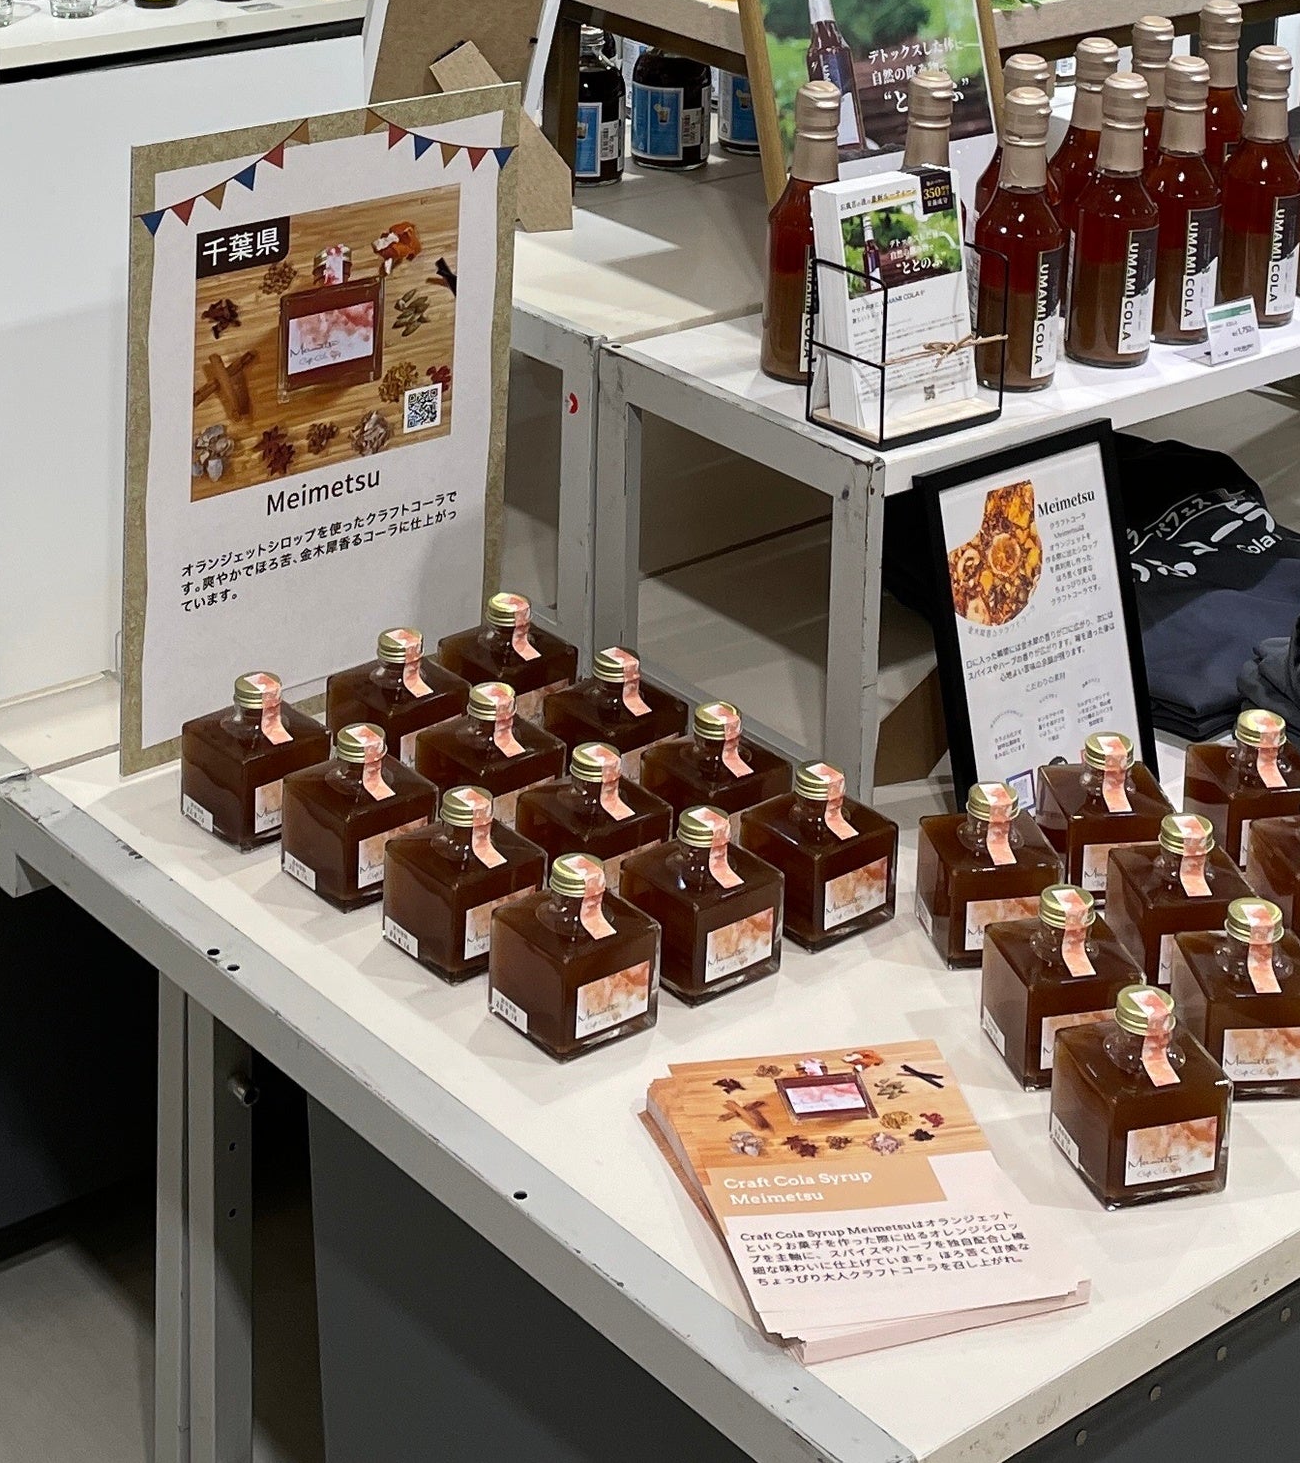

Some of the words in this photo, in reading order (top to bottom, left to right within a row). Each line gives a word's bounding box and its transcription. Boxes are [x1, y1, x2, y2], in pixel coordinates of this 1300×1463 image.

[202, 225, 280, 267] 千葉県
[1184, 221, 1199, 276] UMAMI
[1271, 208, 1286, 260] UMAMI
[1035, 263, 1049, 320] UMAMI
[1124, 242, 1140, 298] UMAMI
[1268, 261, 1280, 304] COLA
[1183, 276, 1195, 319] COLA
[1122, 298, 1134, 342] COLA
[1033, 320, 1045, 366] COLA
[267, 469, 381, 516] Meimetsu
[1037, 489, 1095, 518] Meimetsu
[181, 491, 457, 578] オランジェットシロップを使ったクラフトコーラで
[181, 510, 457, 596] す。爽やかでほろ苦、金木犀香るコーラに仕上がっ
[181, 591, 238, 613] ています。
[723, 1174, 771, 1190] Craft
[774, 1173, 815, 1188] Cola
[818, 1169, 873, 1187] Syrup
[730, 1190, 824, 1206] Meimetsu
[740, 1231, 773, 1242] Craft
[775, 1230, 804, 1240] Cola
[807, 1228, 845, 1240] Syrup
[847, 1211, 1013, 1235] Meimetsuはオランジェット
[745, 1223, 1019, 1253] というお菓子を作った際に出るオレンジシロッ
